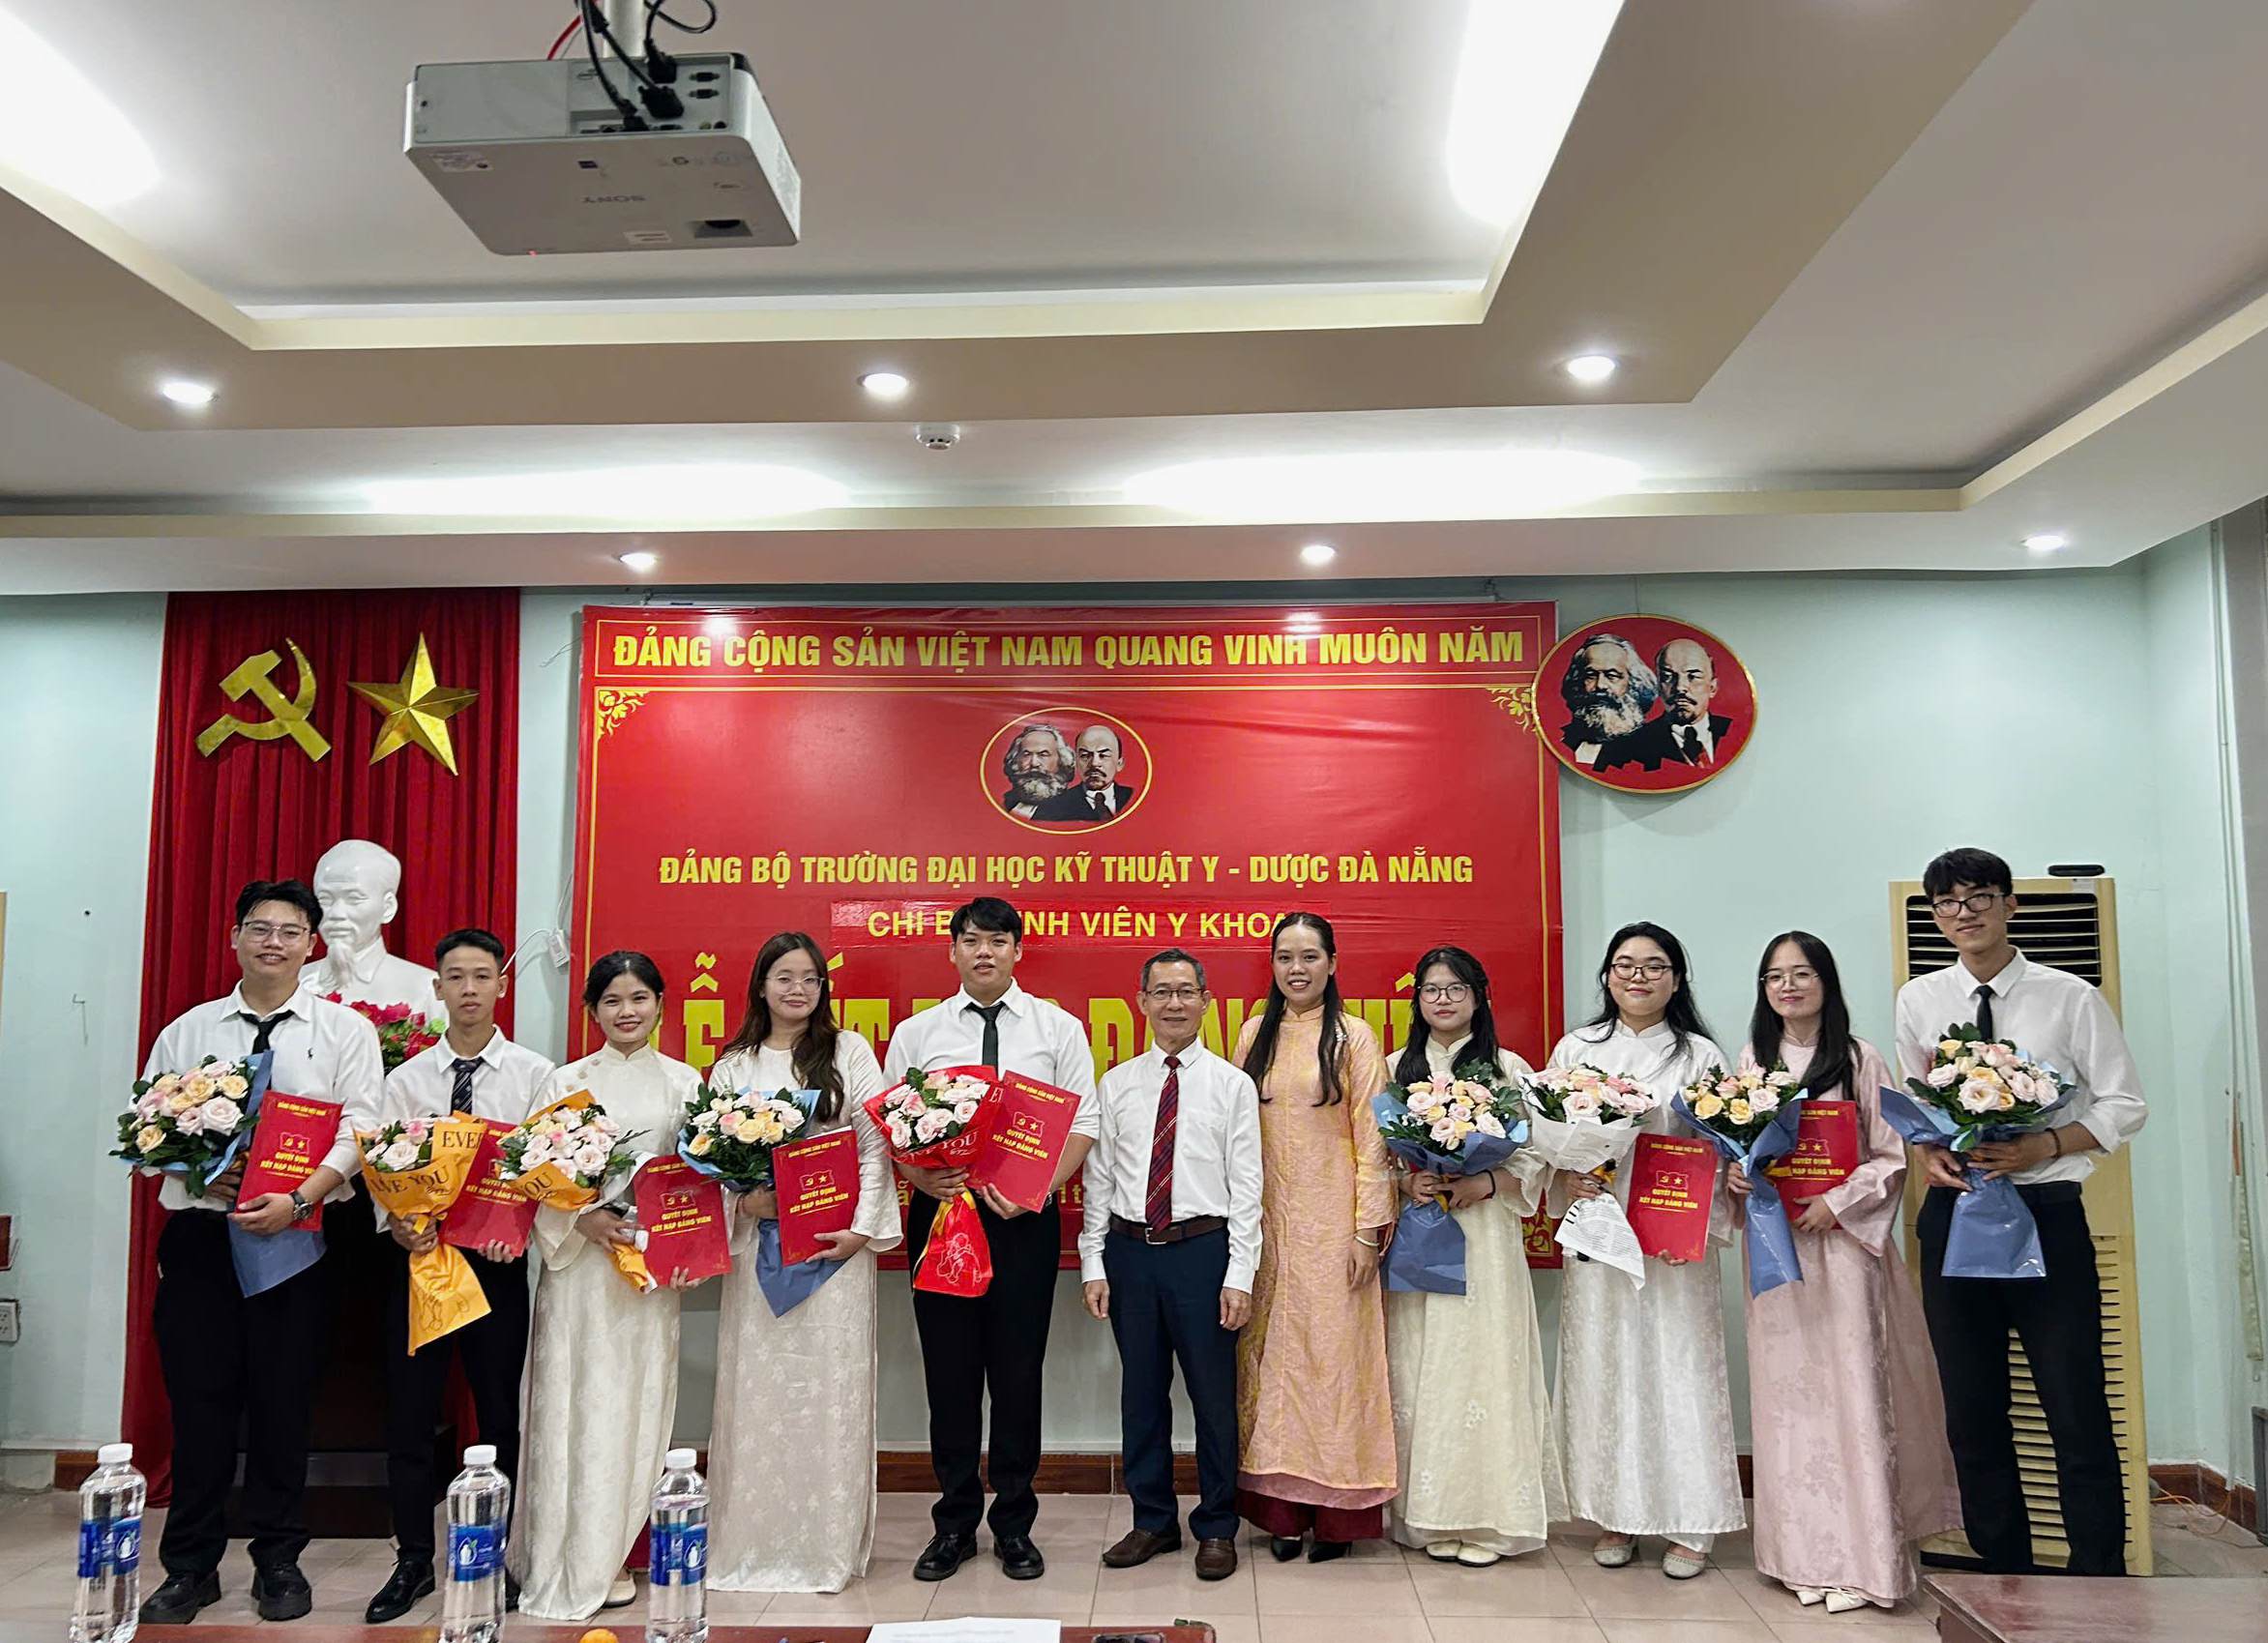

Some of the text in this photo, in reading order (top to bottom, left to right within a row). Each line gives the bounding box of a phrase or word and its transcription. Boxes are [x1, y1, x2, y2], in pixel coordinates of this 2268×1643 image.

[613, 626, 1523, 673] ĐẢNG CỘNG SẢN VIỆT NAM QUANG VINH MUÔN NĂM
[660, 847, 741, 884] ĐẢNG
[751, 851, 791, 890] BỘ
[800, 850, 919, 884] TRƯỜNG
[926, 857, 976, 890] ĐẠI
[987, 857, 1045, 890] HỌC
[1055, 849, 1092, 884] KỸ
[1100, 850, 1193, 890] THUẬT
[1198, 856, 1220, 883] Y
[1249, 852, 1329, 890] DƯỢC
[1338, 850, 1379, 884] ĐÀ
[1388, 845, 1474, 884] NẴNG
[868, 911, 923, 937] CHI
[934, 911, 953, 935] B
[1016, 911, 1069, 935] NH
[1080, 905, 1156, 937] VIÊN
[1166, 913, 1188, 937] Y
[941, 1130, 979, 1150] YOU
[407, 1165, 450, 1187] YOU
